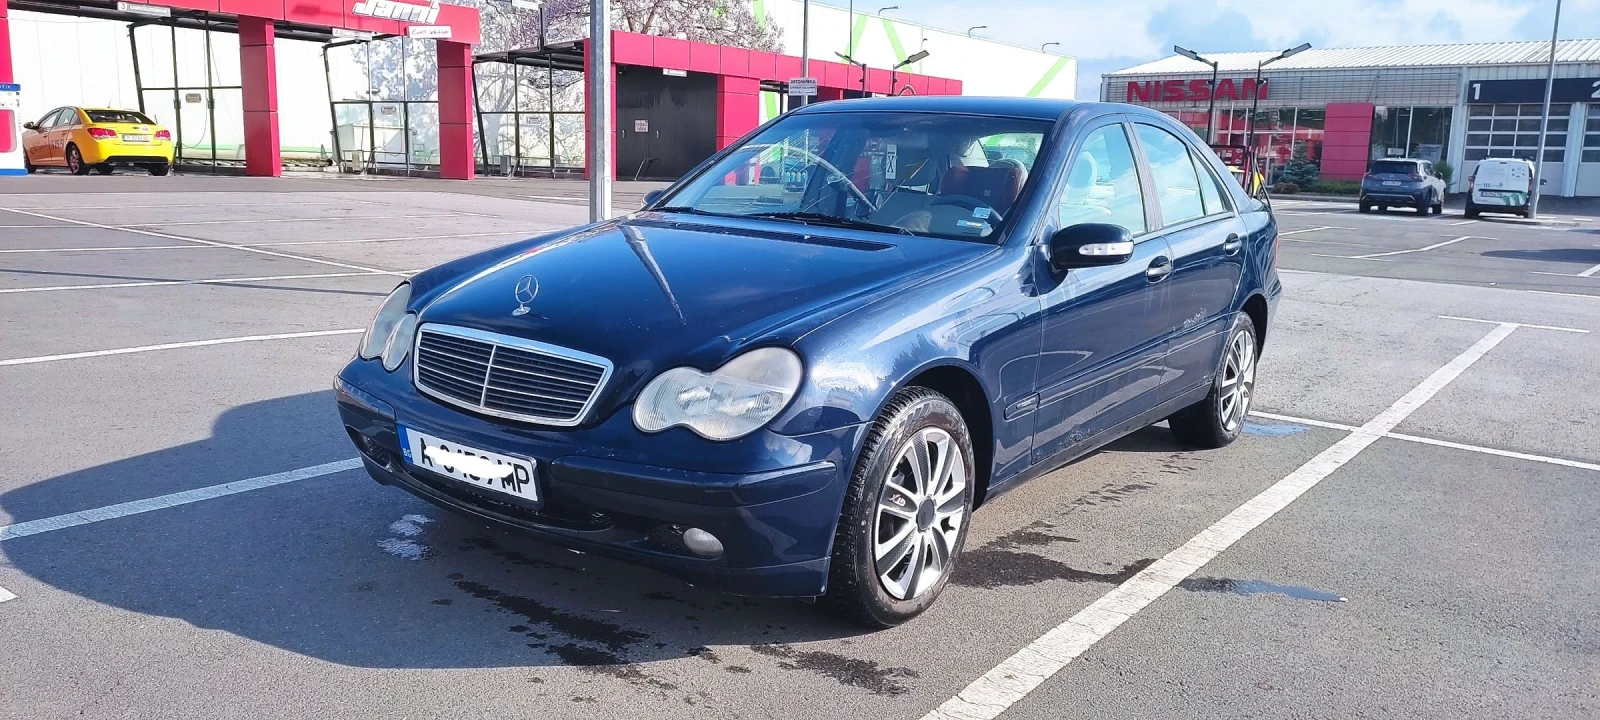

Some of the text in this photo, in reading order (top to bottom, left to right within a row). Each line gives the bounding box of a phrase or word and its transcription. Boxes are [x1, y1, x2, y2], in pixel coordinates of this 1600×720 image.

[1126, 78, 1269, 102] NISSAN
[1472, 83, 1481, 100] 1
[1590, 81, 1600, 99] 2
[403, 448, 412, 458] BG
